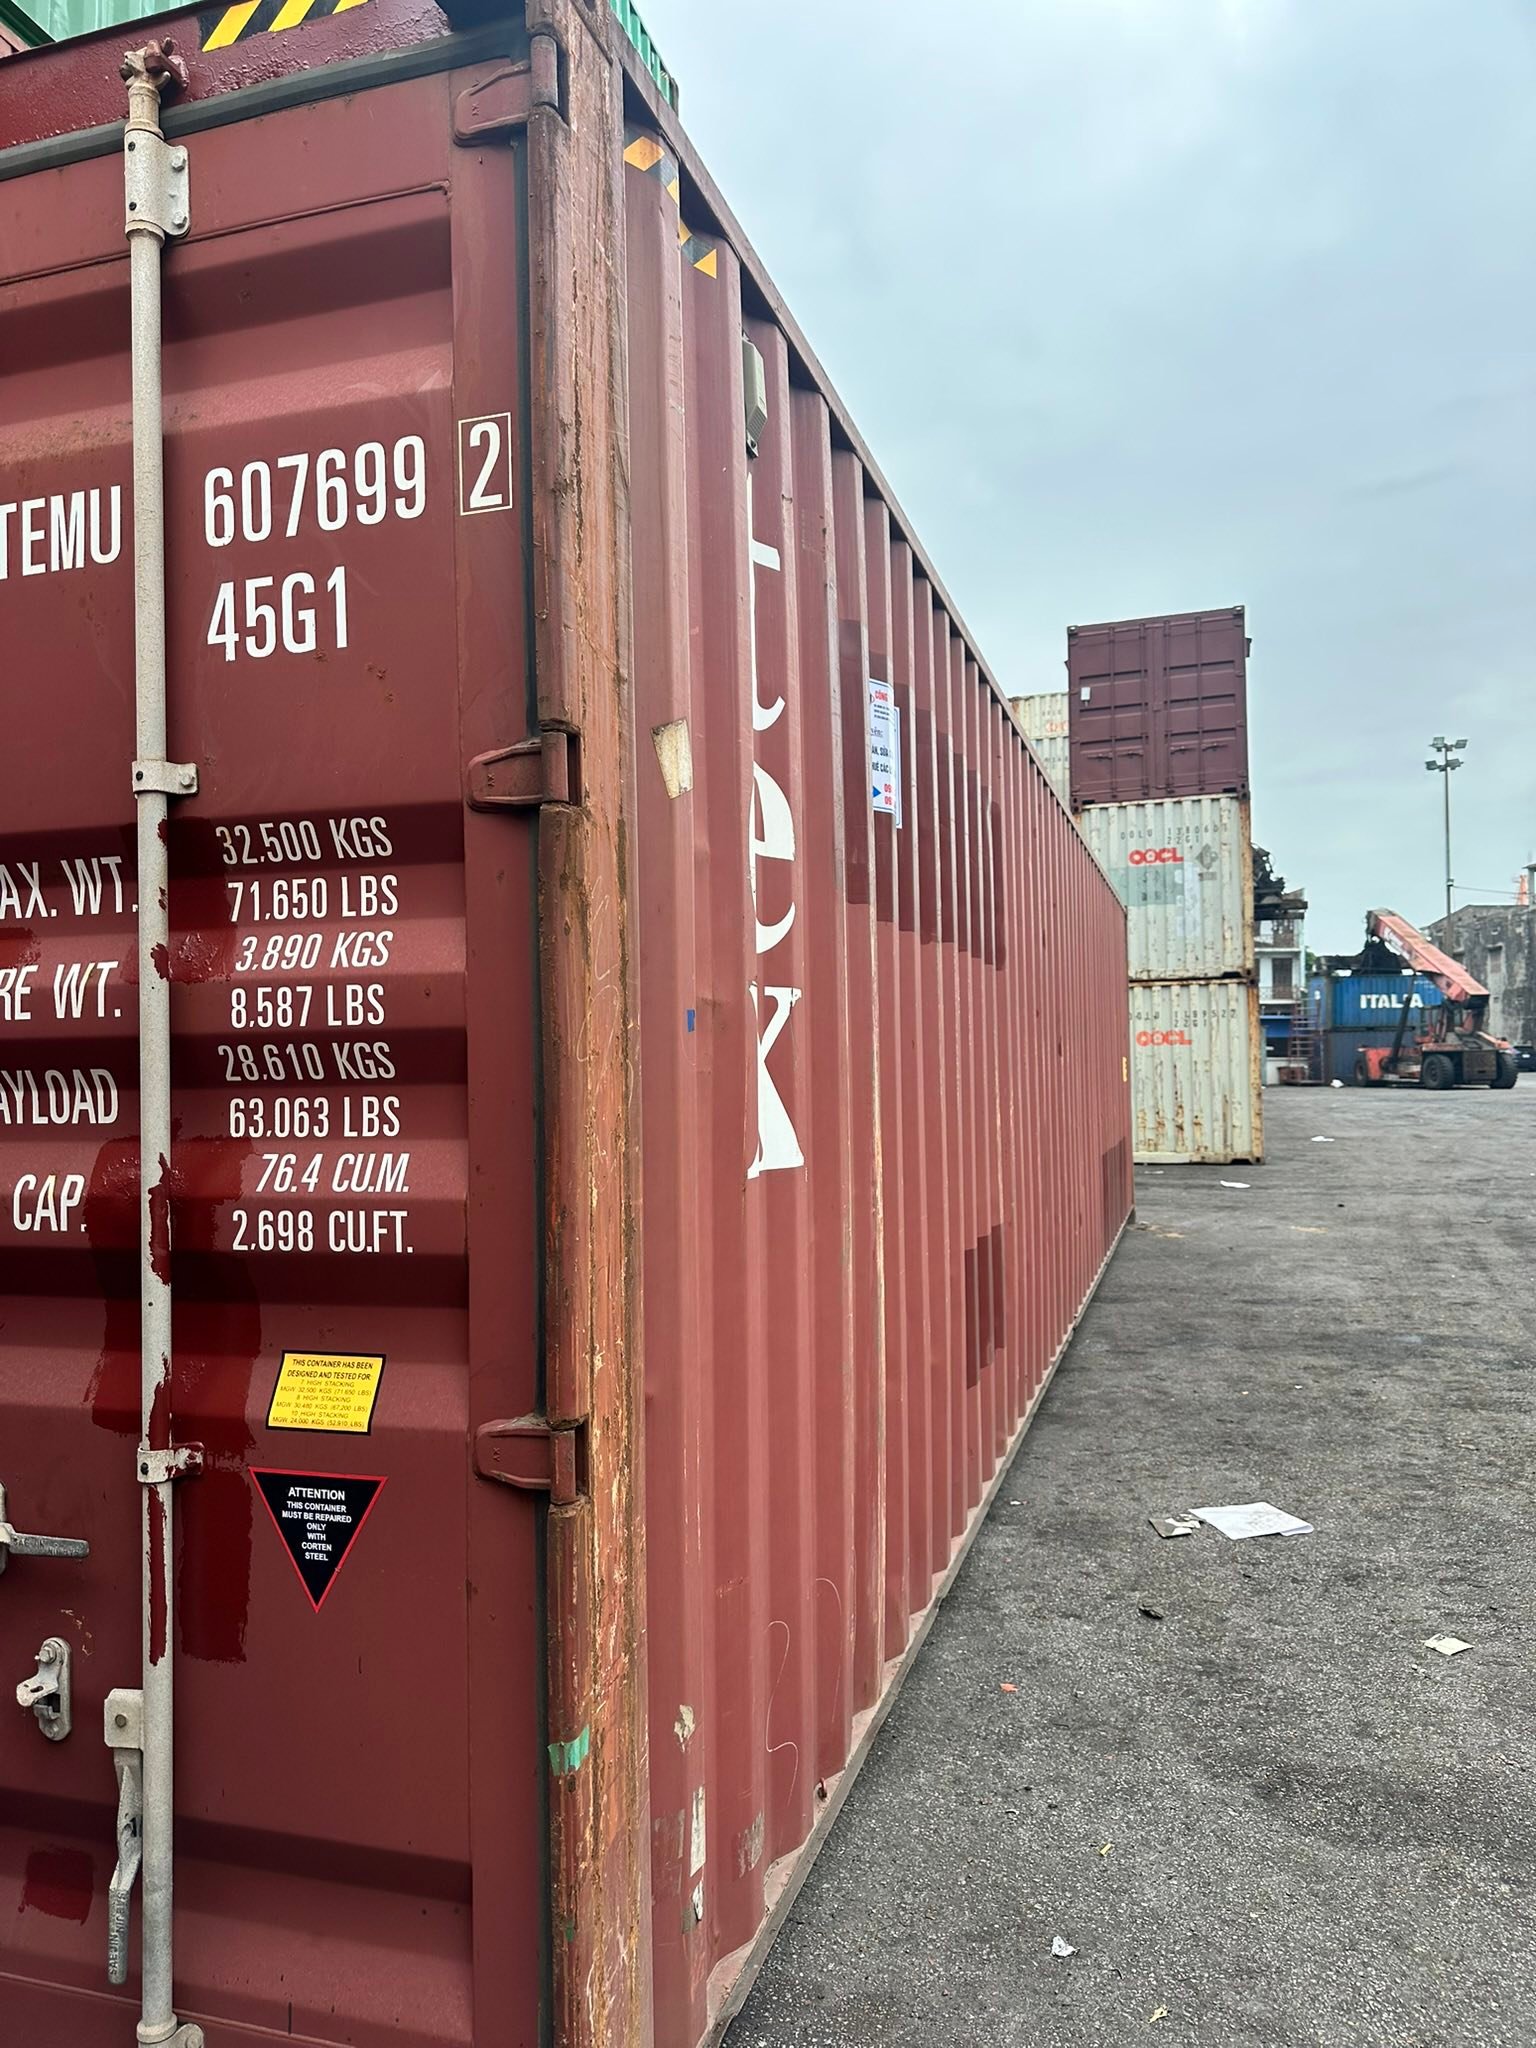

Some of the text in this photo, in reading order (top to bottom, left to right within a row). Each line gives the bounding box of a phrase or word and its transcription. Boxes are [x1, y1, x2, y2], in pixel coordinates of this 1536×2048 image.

[0, 421, 503, 580] TEMU 607699 2
[206, 565, 349, 662] 45G1
[329, 816, 393, 859] KGS
[1128, 847, 1184, 865] OOCL
[60, 856, 139, 916] WT.
[341, 874, 399, 918] LBS
[330, 930, 394, 969] KGS
[53, 961, 121, 1019] WT.
[327, 983, 385, 1027] LBS
[1135, 1030, 1192, 1046] OOCL
[331, 1041, 396, 1080] KGS
[343, 1096, 400, 1137] LBS
[255, 1153, 410, 1193] 76.4 CU.M.
[13, 1174, 87, 1232] CAP.
[328, 1209, 414, 1253] CU.FT.
[287, 1369, 319, 1378] DESIGNED
[318, 1371, 333, 1379] AND
[333, 1371, 357, 1380] TESTED
[292, 1358, 374, 1370] THIS CONTAINER HAS BEEN
[286, 1500, 347, 1513] THIS CONTAINER
[288, 1486, 345, 1501] ATTENTION
[281, 1510, 352, 1523] MUST BE REPAIRED
[306, 1522, 327, 1531] ONLY
[301, 1541, 332, 1552] CORTEN
[307, 1532, 327, 1541] WITH
[304, 1551, 329, 1562] STEEL
